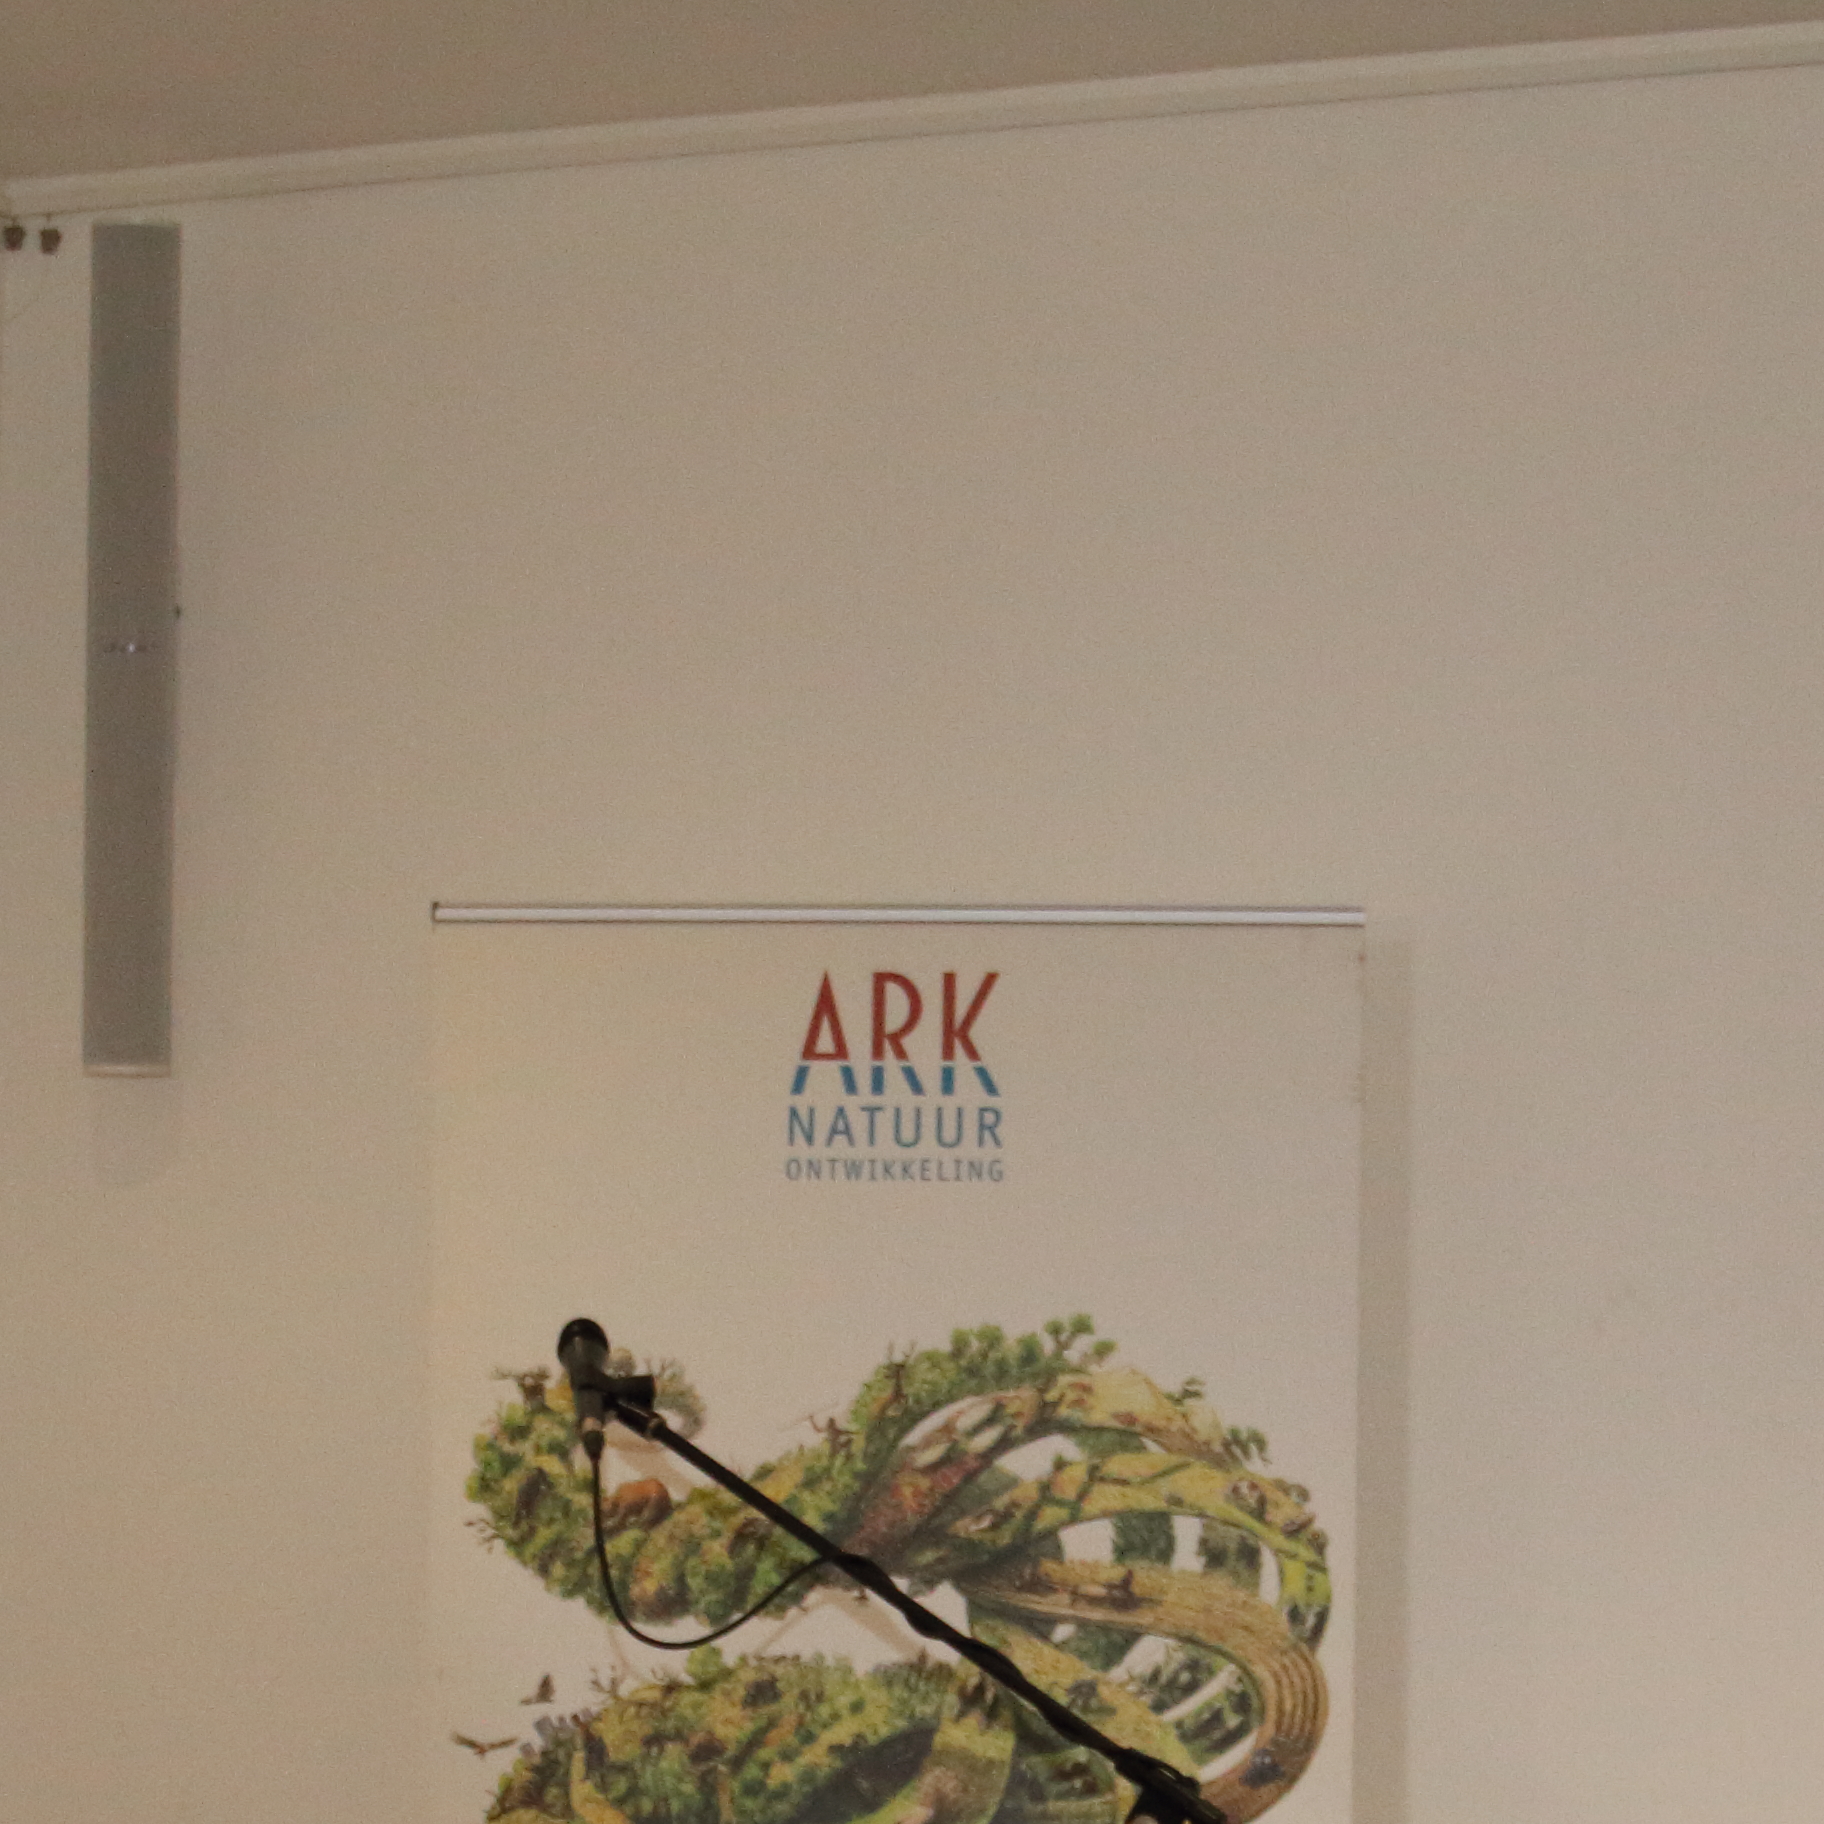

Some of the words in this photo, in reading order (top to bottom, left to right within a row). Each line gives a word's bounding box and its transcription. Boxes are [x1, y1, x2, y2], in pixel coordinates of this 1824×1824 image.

[789, 970, 1001, 1097] ARK
[787, 1105, 1004, 1149] NATUUR
[784, 1157, 1005, 1183] ONTWIKKELING
